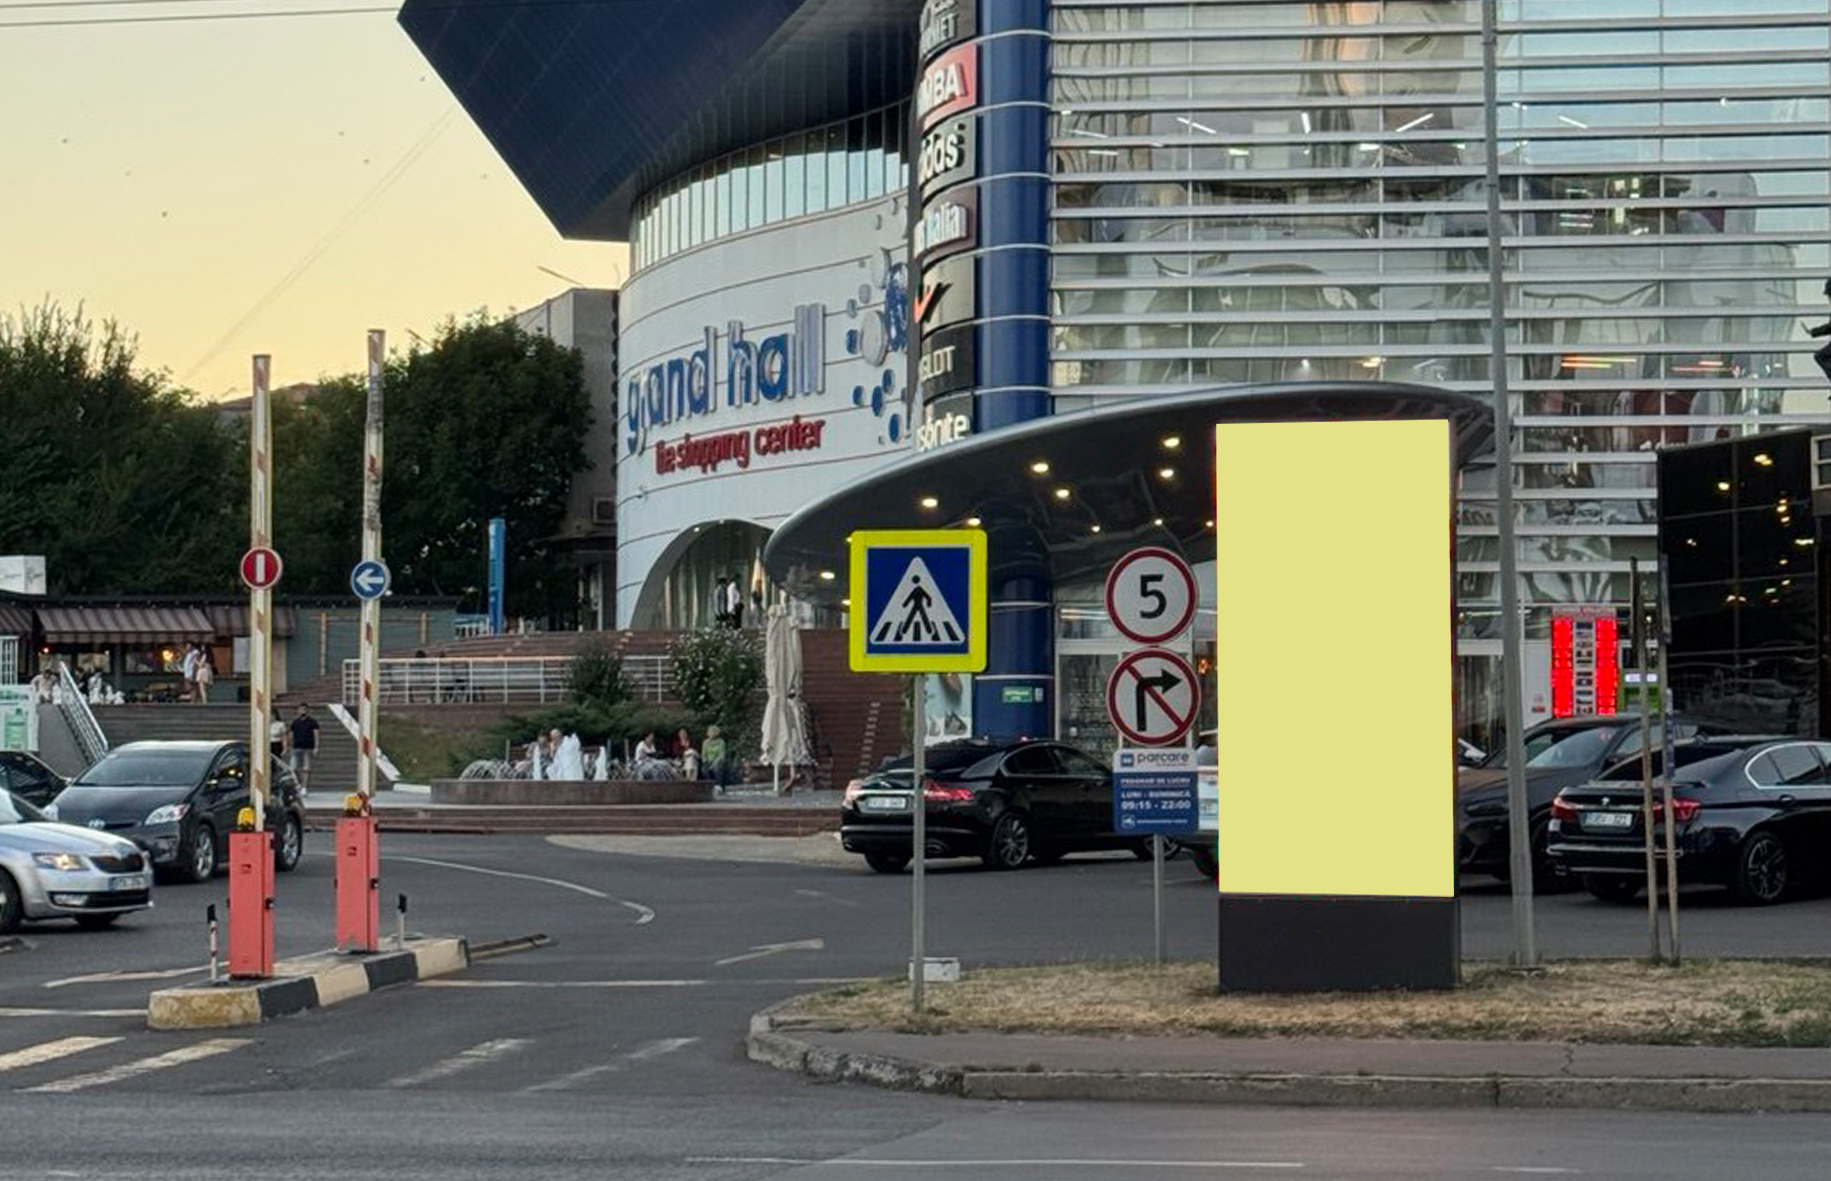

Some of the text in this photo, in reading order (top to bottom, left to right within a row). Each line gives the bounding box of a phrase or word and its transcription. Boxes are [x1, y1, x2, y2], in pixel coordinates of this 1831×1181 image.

[627, 302, 826, 457] grand hall
[755, 415, 826, 456] center
[1139, 574, 1167, 619] 5
[1137, 752, 1190, 764] parcare
[1161, 799, 1191, 810] 22:00
